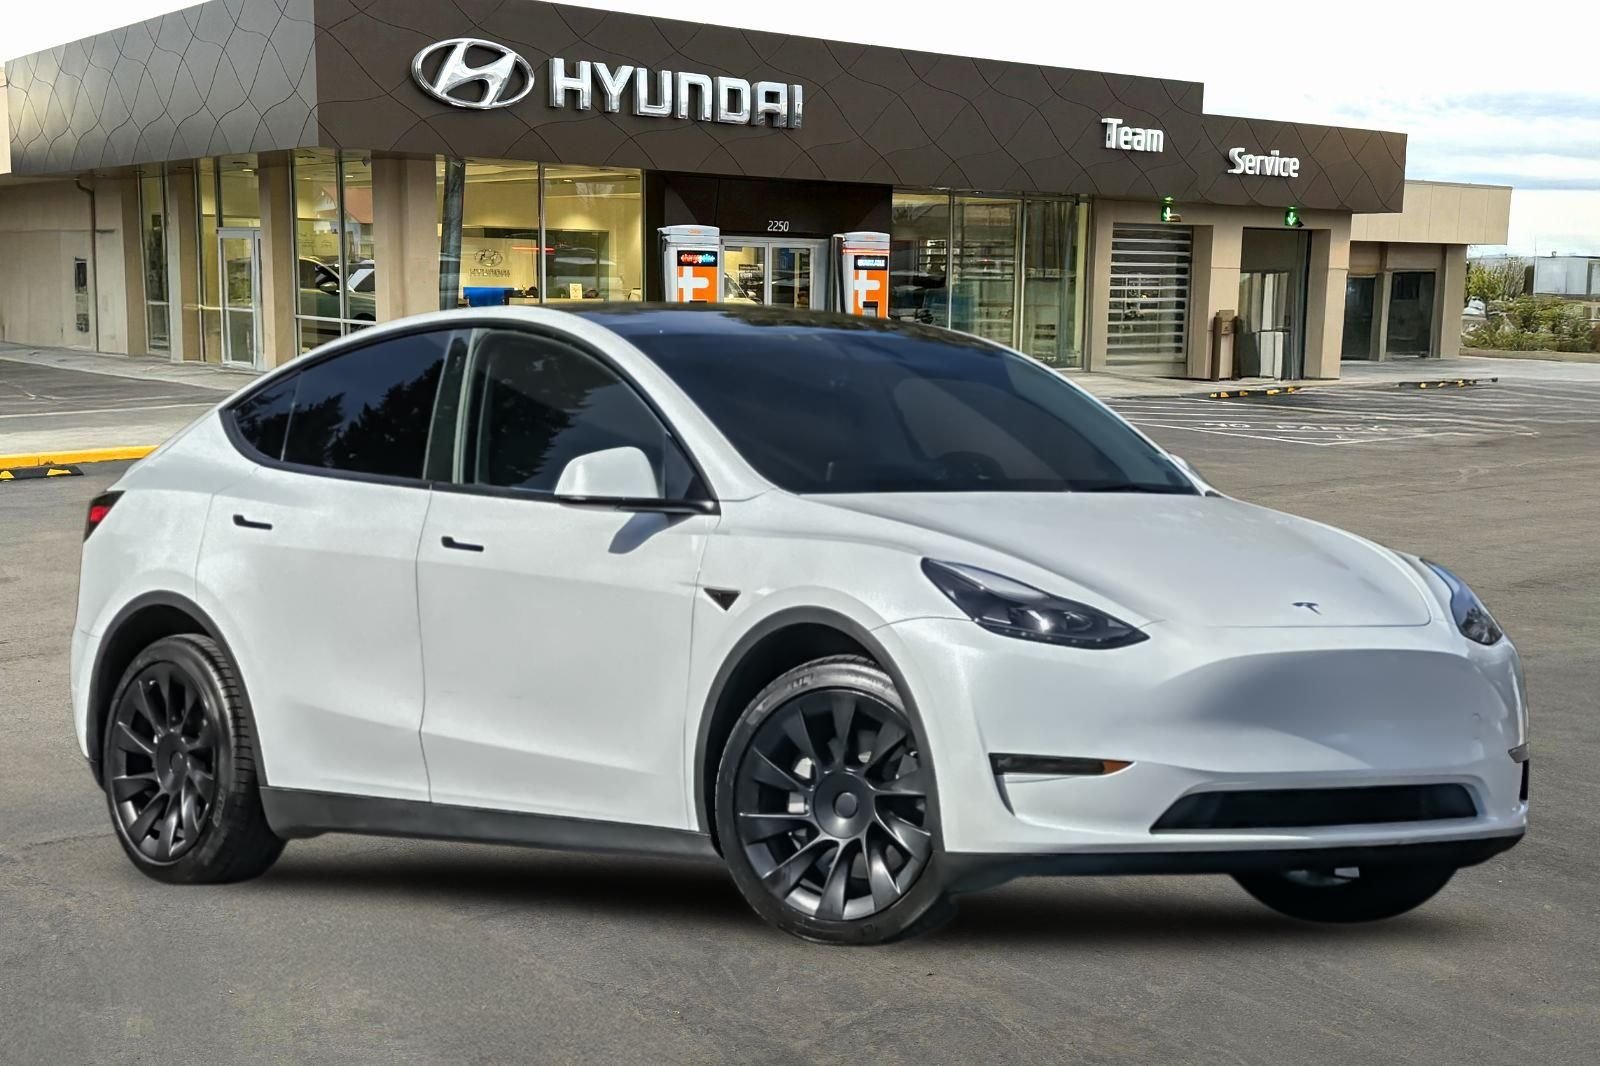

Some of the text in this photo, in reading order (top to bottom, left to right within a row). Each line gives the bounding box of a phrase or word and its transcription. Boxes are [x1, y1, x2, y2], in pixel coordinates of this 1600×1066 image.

[549, 57, 803, 128] HYUNDAI
[1101, 117, 1165, 153] Team
[1227, 147, 1300, 178] Service
[767, 220, 790, 232] 2250
